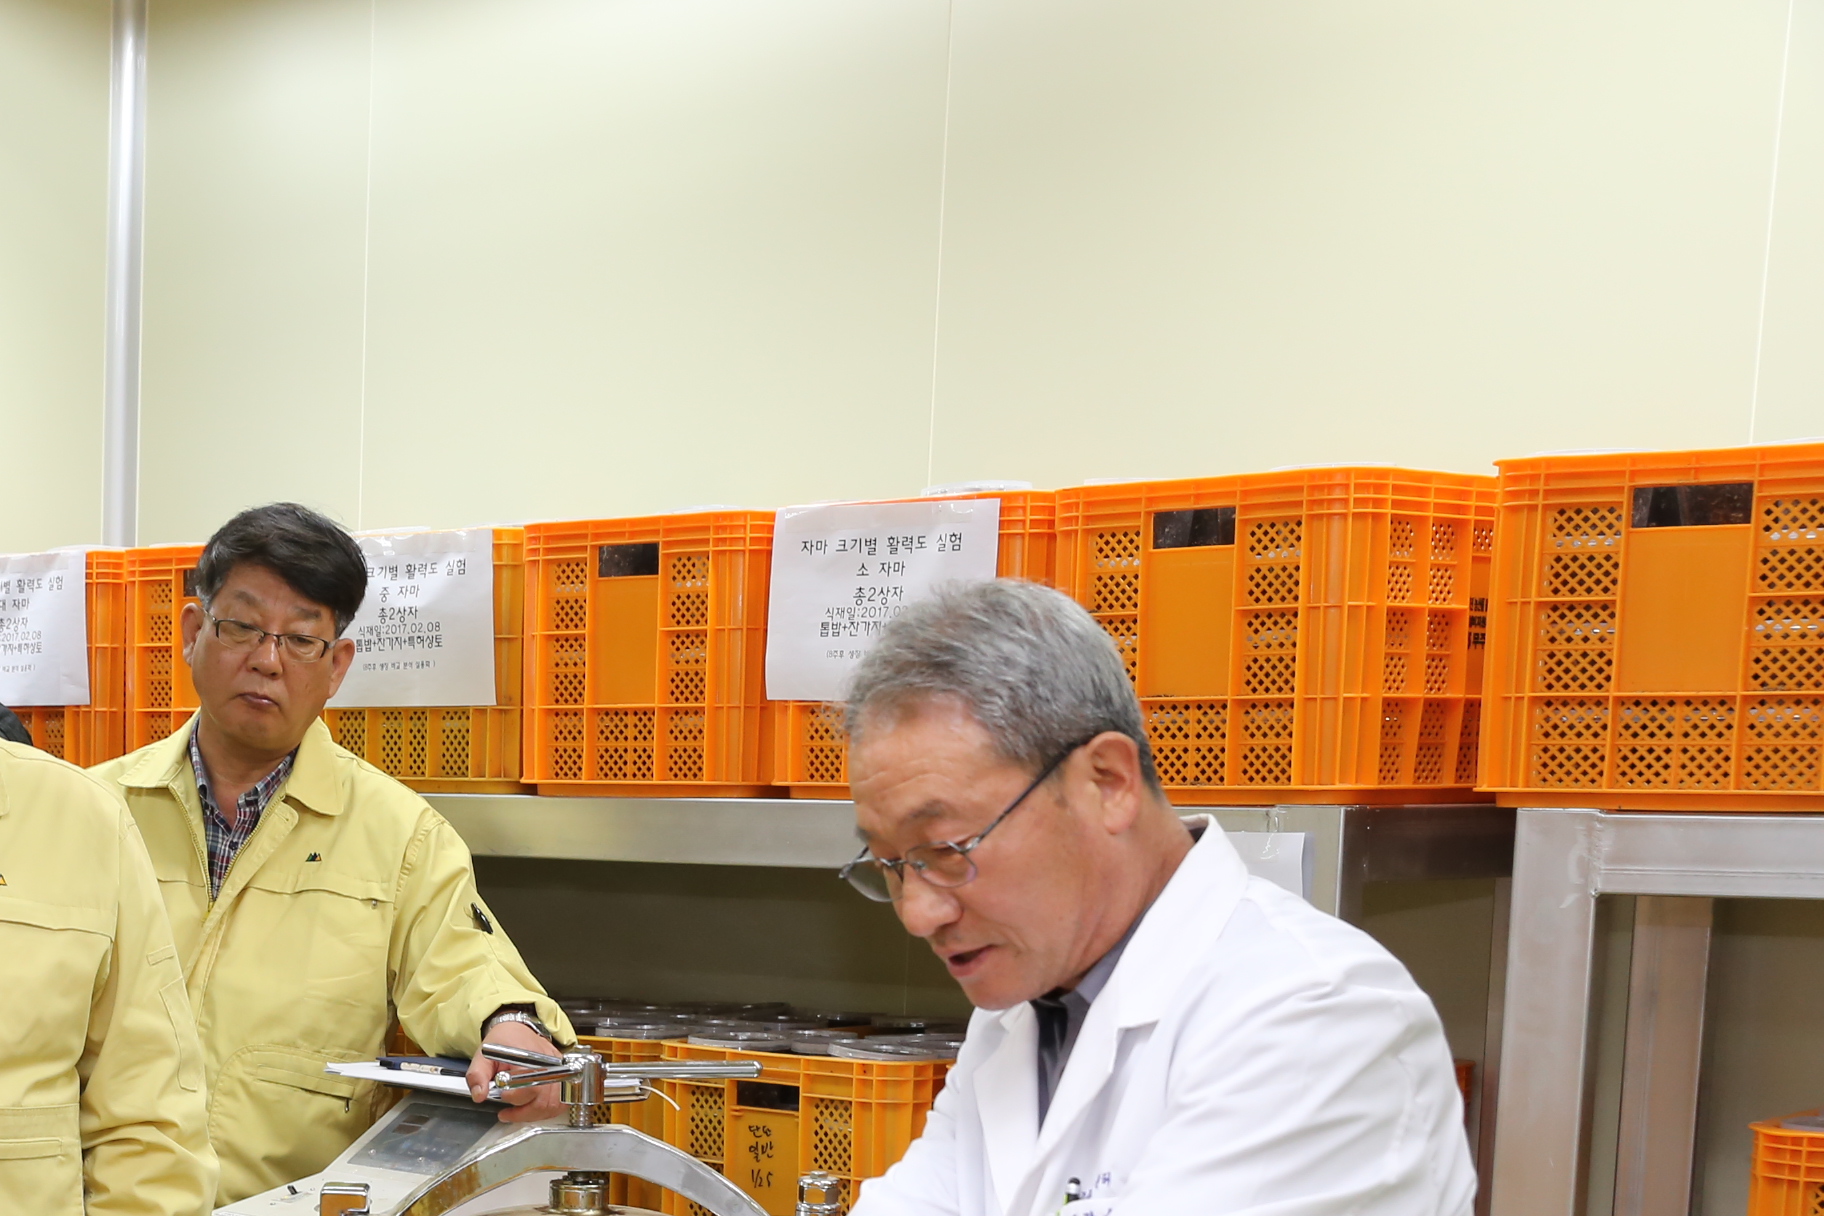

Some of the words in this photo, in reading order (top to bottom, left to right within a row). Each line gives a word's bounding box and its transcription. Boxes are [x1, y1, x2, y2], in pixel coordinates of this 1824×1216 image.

[800, 539, 828, 556] 자마
[835, 536, 877, 556] 크기별
[886, 534, 928, 555] 활력도
[936, 532, 963, 552] 실험
[366, 564, 398, 581] 크기별
[405, 562, 438, 580] 활력도
[445, 558, 466, 576] 실험
[856, 562, 870, 577] 소
[878, 560, 906, 577] 자마
[16, 578, 43, 594] 활력도
[48, 575, 64, 592] 실험
[379, 586, 390, 603] 중
[397, 584, 420, 599] 자마
[11, 597, 30, 611] 자마
[852, 585, 904, 606] 총2상자
[378, 605, 419, 625] 총2상자
[358, 621, 441, 638] 식재일:2017.02.08
